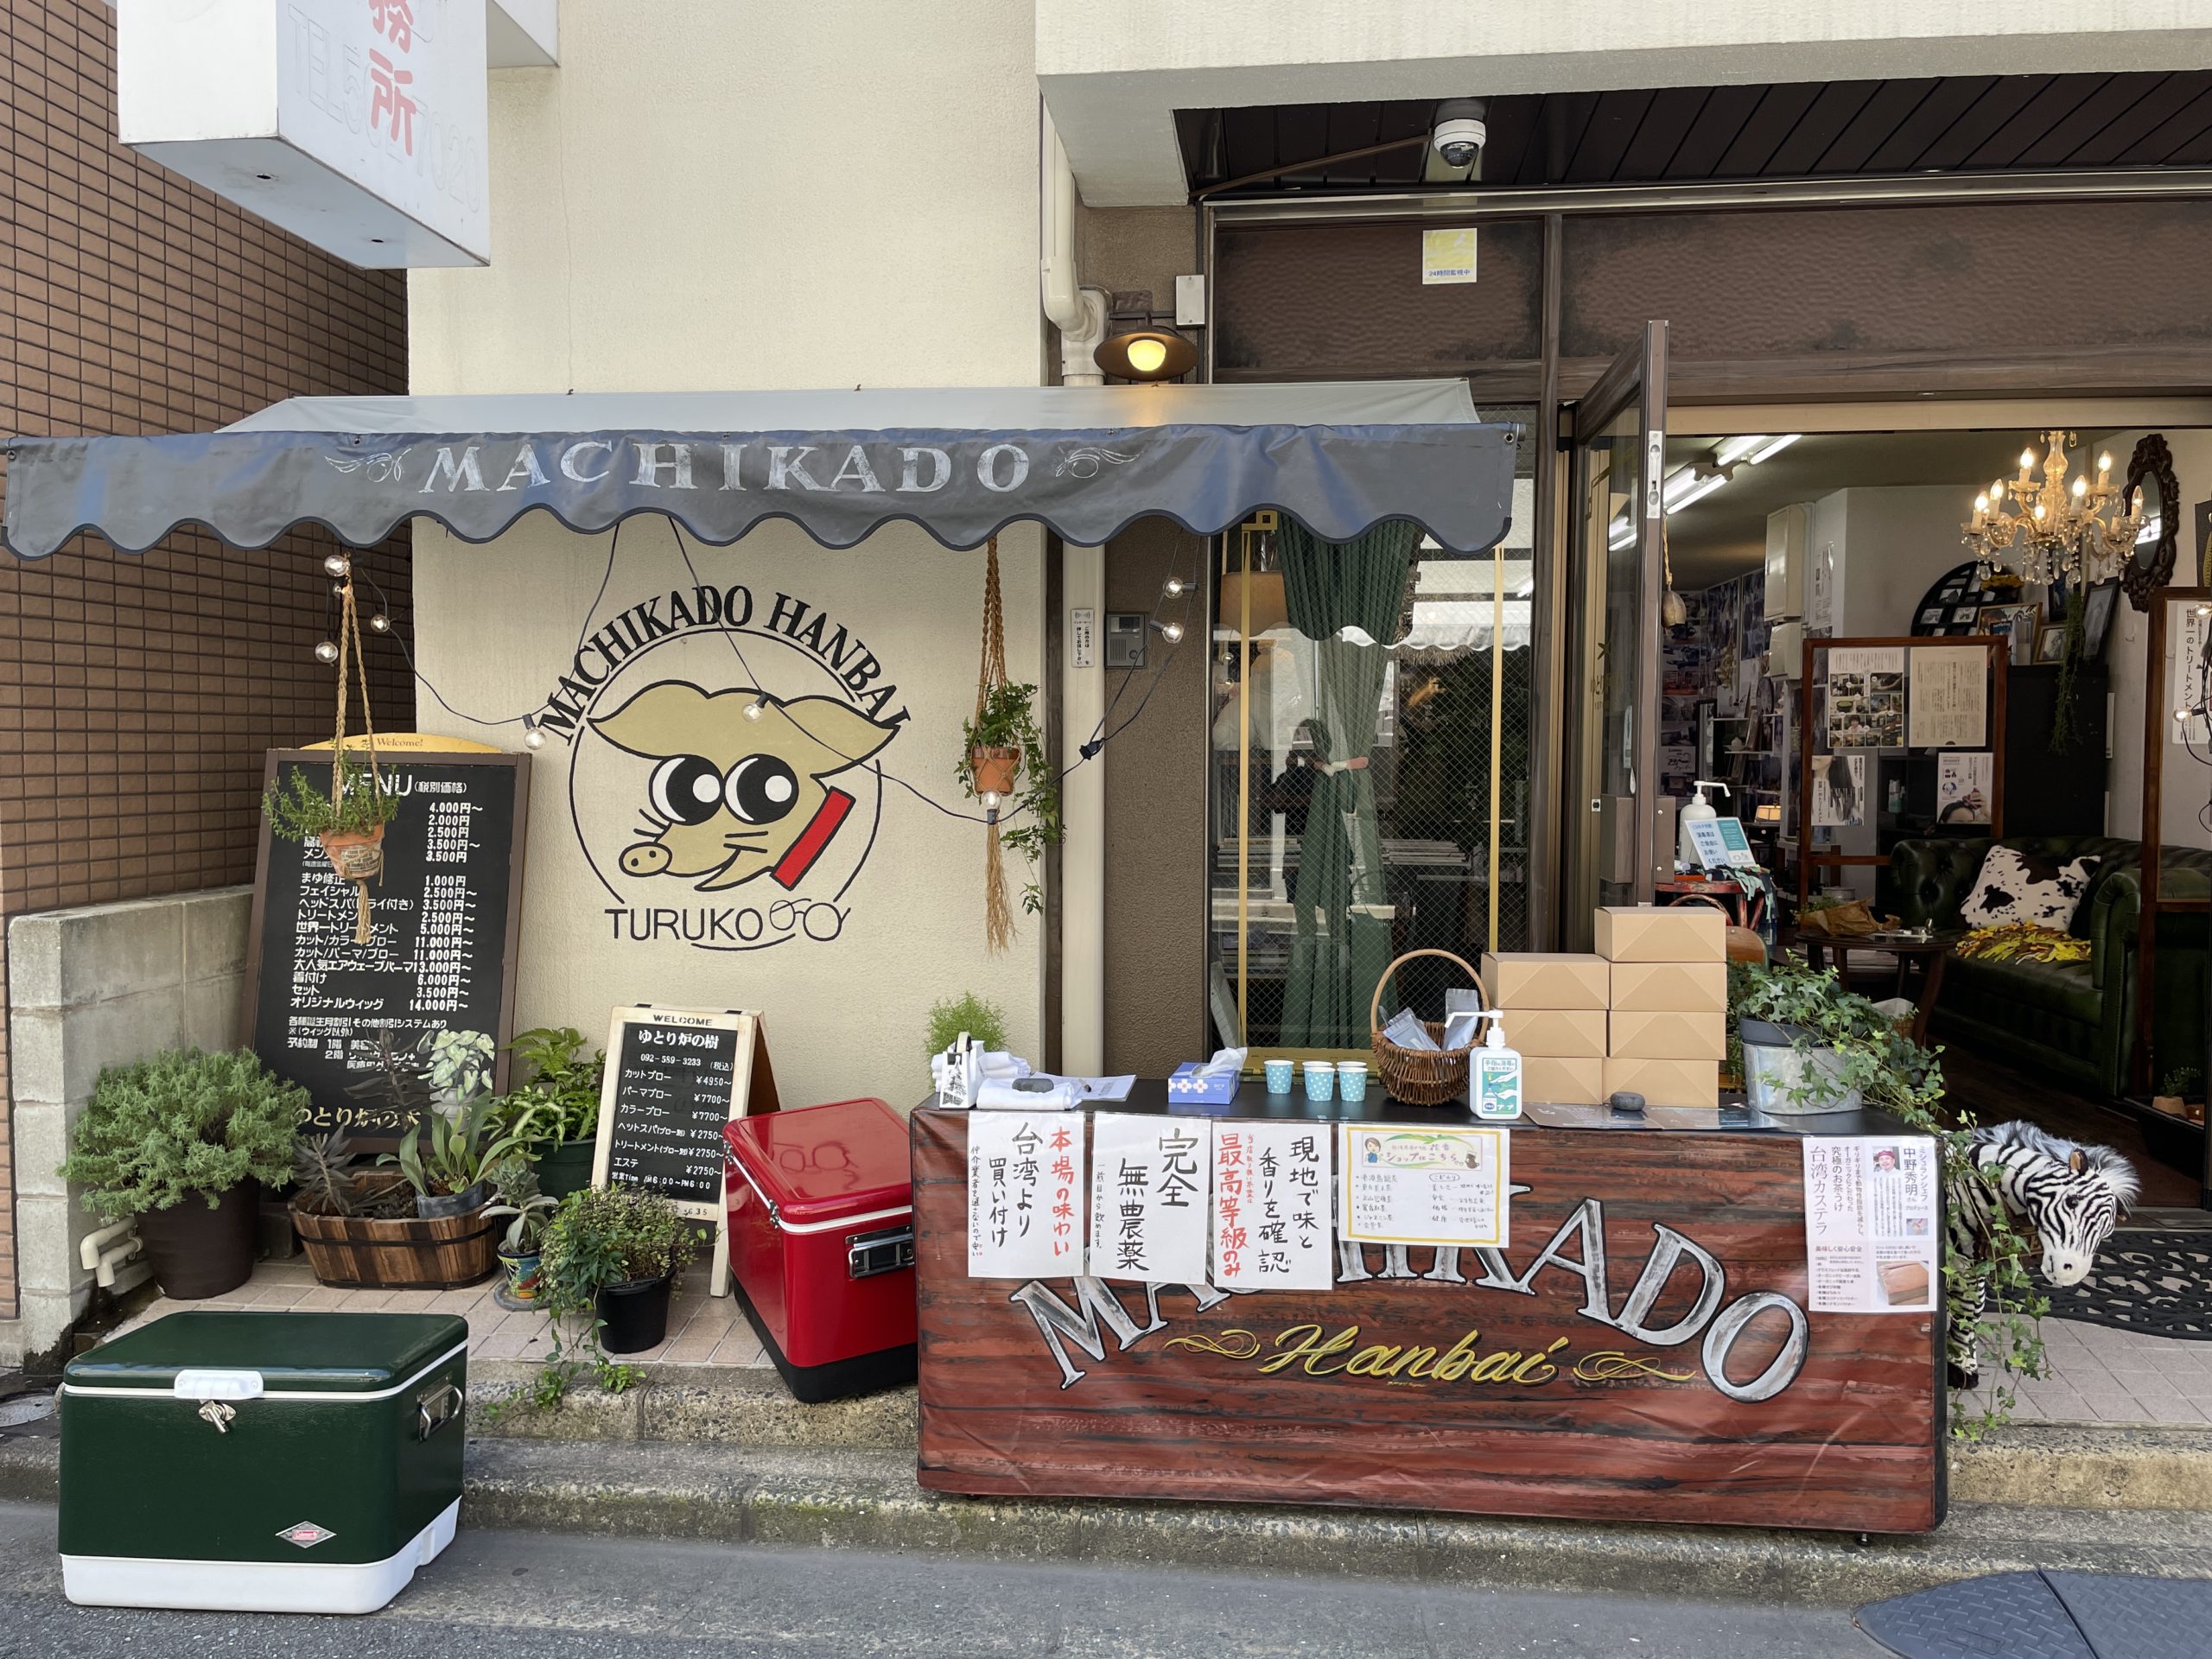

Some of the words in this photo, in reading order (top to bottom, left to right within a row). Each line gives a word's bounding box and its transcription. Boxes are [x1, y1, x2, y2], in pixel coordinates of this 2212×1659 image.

[418, 441, 1032, 494] MACHIKADO
[537, 585, 753, 747] MACHIKADO
[764, 592, 912, 728] HANBAI
[377, 738, 423, 747] Welcome!
[301, 873, 346, 885] まゆ修正
[297, 910, 359, 922] トリートメン
[299, 898, 414, 911] ヘッドスパ(ライ付き)
[296, 921, 398, 934] 世界一トリーメント
[605, 908, 764, 941] TURUKO
[295, 934, 397, 946] カット/カラーブロー
[295, 947, 399, 959] カット/パーマ/ブロー
[291, 984, 320, 995] セット
[292, 971, 327, 983] 着付け
[290, 996, 385, 1010] オリジナルウィッグ
[653, 1014, 713, 1027] WELCOME
[638, 1029, 720, 1050] ゆとり炉の樹
[625, 1068, 671, 1081] カットブロー
[622, 1086, 672, 1099] パーマブロー
[620, 1103, 670, 1116] カラーブロー
[613, 1157, 639, 1168] エステ
[1156, 1128, 1199, 1207] 完全
[1904, 1147, 1918, 1196] 中野秀明
[1919, 1146, 1929, 1202] ミシュランシェフ
[1011, 1122, 1044, 1237] 台湾より
[1049, 1126, 1075, 1257] 本場の味わい
[1289, 1135, 1320, 1249] 現地で味と
[1810, 1146, 1828, 1236] 台湾カステラ
[1831, 1146, 1843, 1211] 究極のお茶うけ
[988, 1157, 1008, 1248] 買い付け
[1116, 1157, 1151, 1271] 無農薬
[1218, 1133, 1249, 1278] 最高等級のみ
[1258, 1147, 1292, 1274] 香りを確認
[1257, 1324, 1568, 1383] Hanbai
